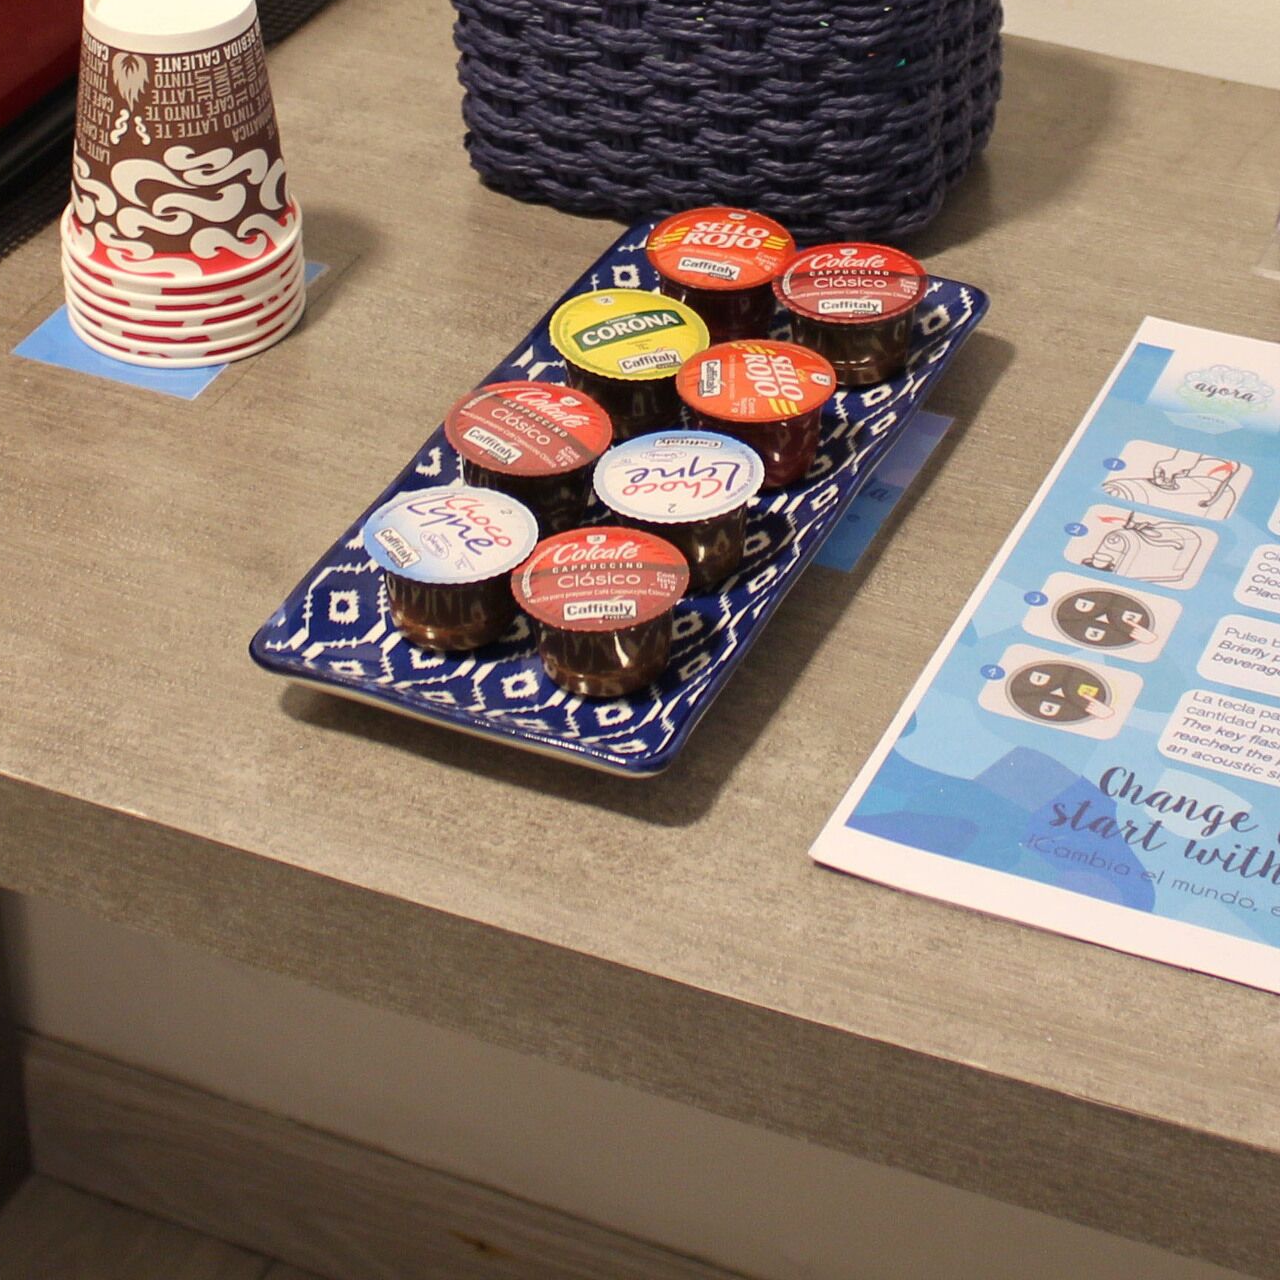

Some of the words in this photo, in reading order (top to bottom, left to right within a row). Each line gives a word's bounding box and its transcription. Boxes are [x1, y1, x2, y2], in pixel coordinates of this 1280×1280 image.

[154, 49, 221, 73] CALIENTE
[154, 72, 195, 89] TINTO
[194, 68, 214, 103] LATTE
[212, 61, 231, 98] TINTO
[152, 88, 195, 105] LATTE
[145, 106, 161, 121] TE
[164, 104, 203, 122] TINTO
[223, 104, 255, 129] TINTO
[155, 123, 173, 139] TE
[177, 117, 218, 138] LATTE
[681, 232, 762, 249] ROJO
[692, 221, 770, 239] SELLO
[681, 258, 737, 278] Caffitaly
[809, 253, 888, 270] Colcafé
[809, 269, 889, 277] CAPPUCCINO
[814, 276, 887, 288] Clásico
[821, 300, 880, 312] Caffitaly
[582, 312, 679, 346] CORONA
[622, 352, 677, 370] Caffitaly
[706, 361, 718, 394] Caffitaly
[742, 353, 780, 397] ROJO
[769, 355, 804, 401] SELLO
[1194, 382, 1257, 401] agora
[503, 399, 568, 438] CAPPUCCINO
[516, 391, 590, 428] Colcafé
[491, 407, 551, 446] Clásico
[469, 429, 517, 459] Caffitaly
[625, 456, 740, 491] Lyne
[622, 478, 723, 499] Choco
[406, 495, 494, 556] Lyne
[445, 497, 512, 548] Choco
[380, 528, 413, 563] Caffitaly
[552, 542, 644, 565] Colcafé
[552, 562, 644, 574] CAPPUCCINO
[557, 572, 641, 588] Clásico
[566, 603, 634, 617] Caffitaly
[1217, 639, 1271, 660] Briefly
[1165, 744, 1188, 756] an
[1190, 750, 1264, 775] acoustic
[1099, 766, 1259, 837] Change
[1049, 800, 1167, 852] start
[1140, 870, 1165, 887] el
[1170, 880, 1258, 913] mundo,
